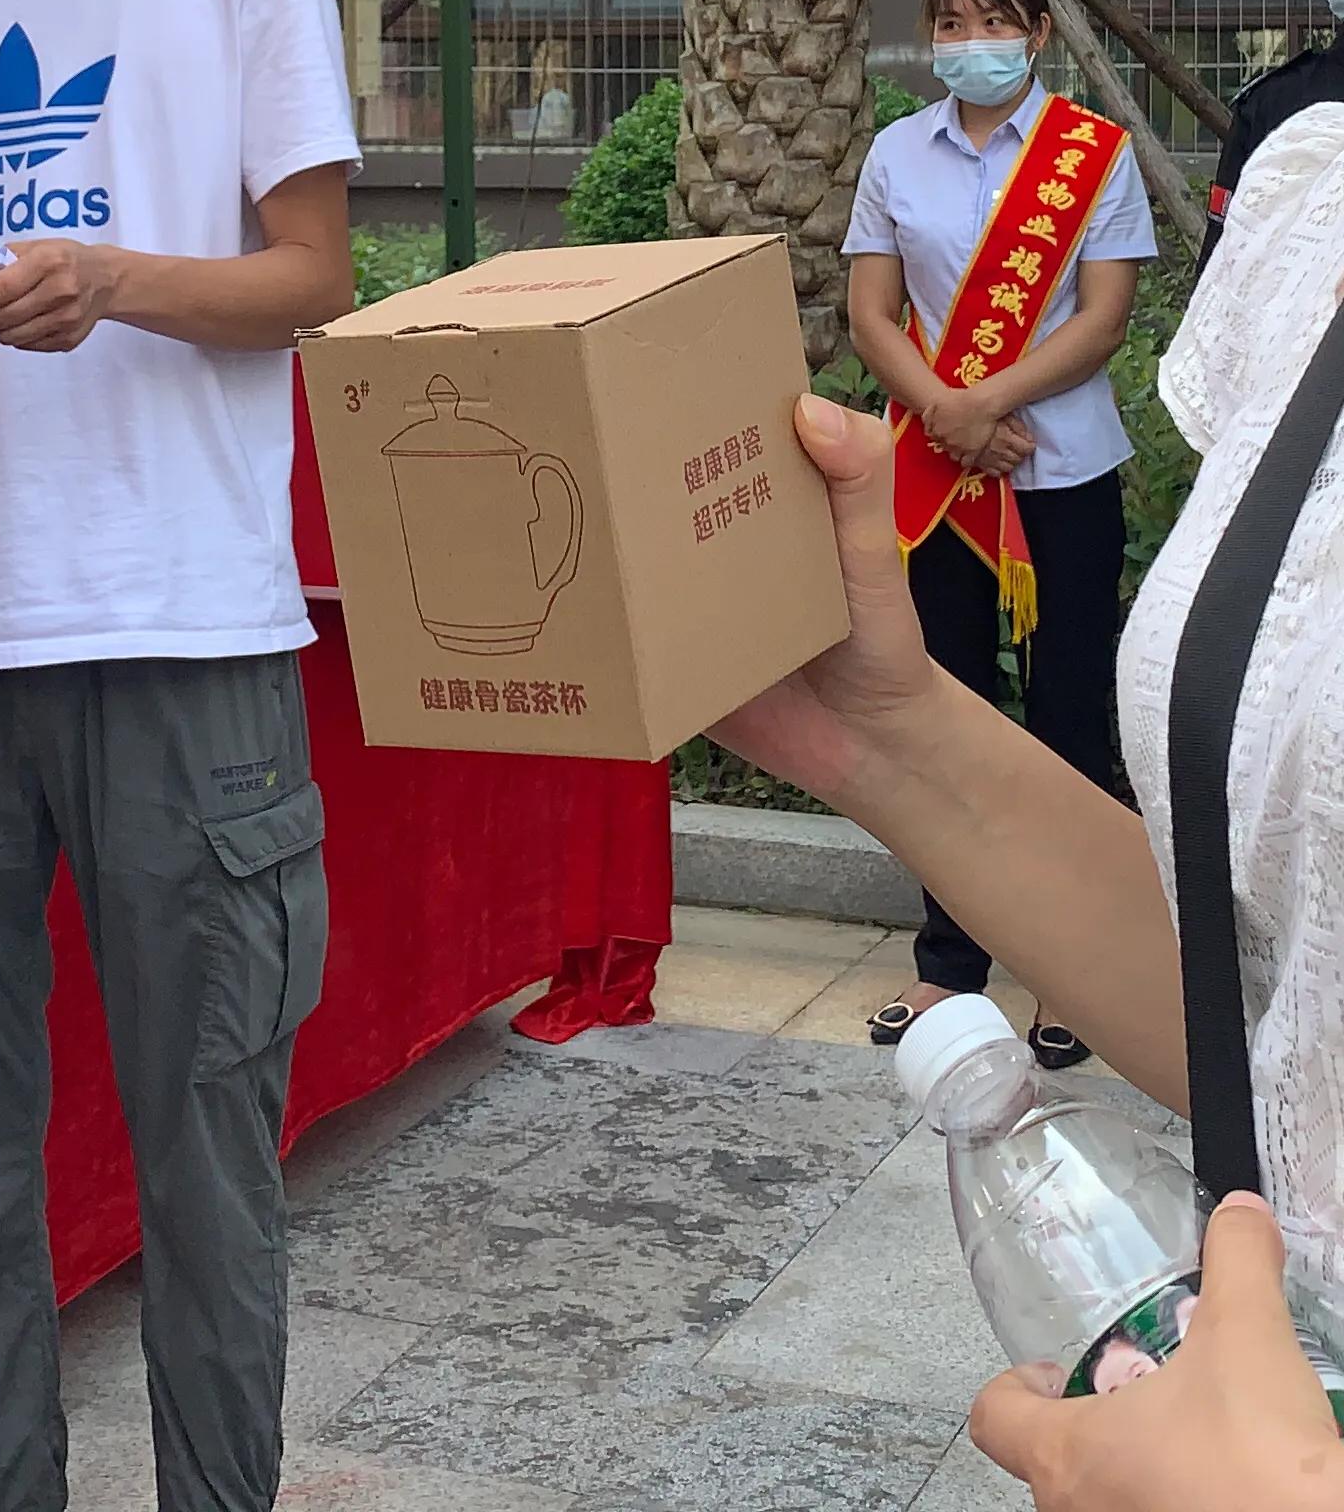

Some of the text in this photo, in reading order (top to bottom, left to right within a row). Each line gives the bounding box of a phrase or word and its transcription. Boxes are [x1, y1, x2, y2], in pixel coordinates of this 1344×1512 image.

[684, 425, 764, 495] 健康骨瓷
[693, 472, 772, 544] 超市专供
[420, 677, 588, 716] 健康骨瓷茶杯
